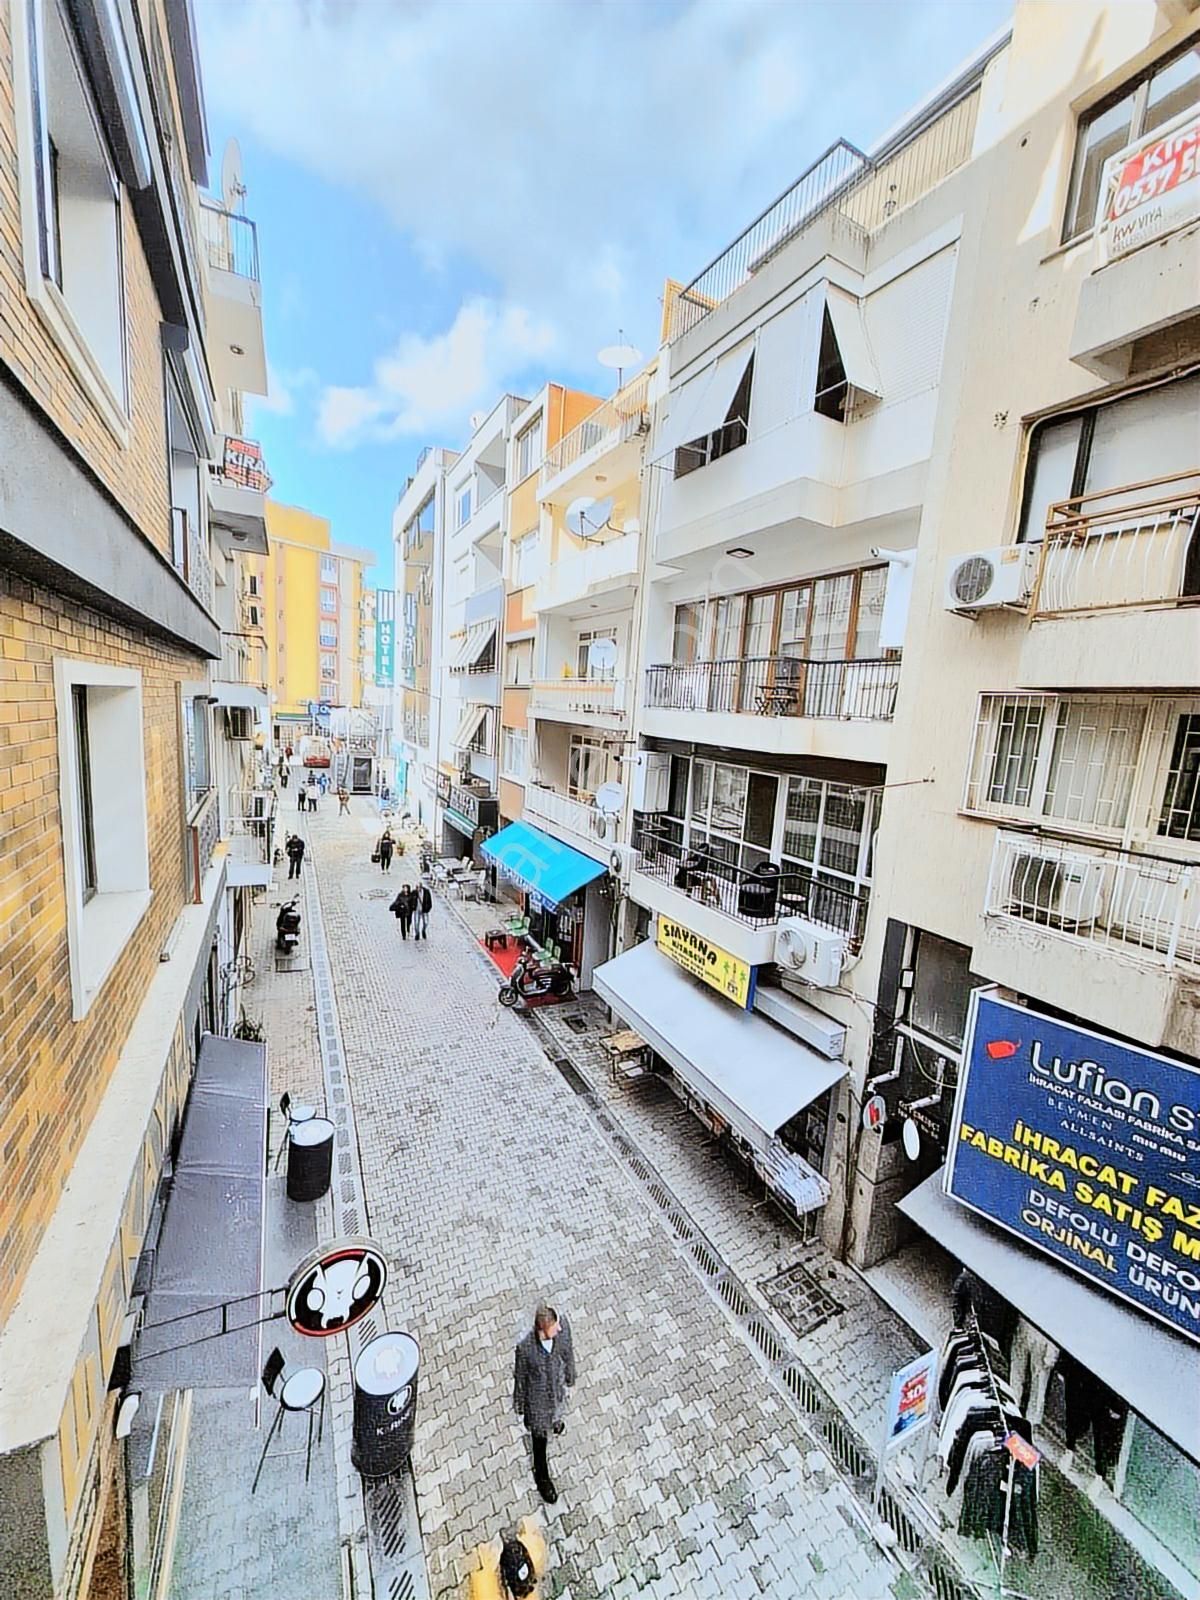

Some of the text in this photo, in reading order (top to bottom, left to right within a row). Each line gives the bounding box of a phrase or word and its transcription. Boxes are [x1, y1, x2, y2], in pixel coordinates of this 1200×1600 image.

[1112, 156, 1178, 217] 0537
[381, 623, 391, 676] HOTEL
[1031, 1041, 1160, 1119] Lufian
[1047, 1095, 1114, 1131] BEYMEN
[1060, 1119, 1144, 1162] ALLSAINTS
[959, 1123, 1068, 1193] FABRİKA
[1074, 1181, 1164, 1243] SATIŞ
[1013, 1119, 1139, 1195] İHRACAT
[1021, 1208, 1119, 1273] ORJİNAL
[1028, 1188, 1120, 1247] DEFOLU
